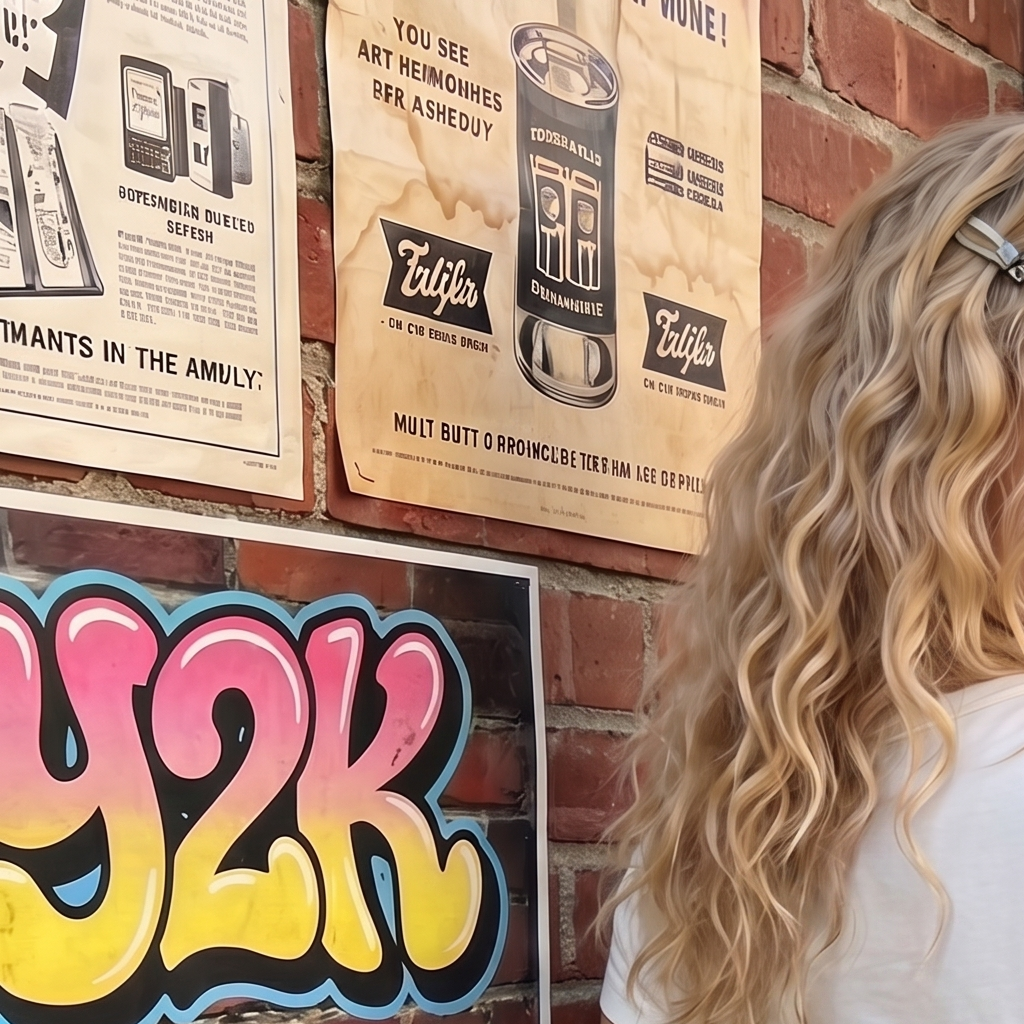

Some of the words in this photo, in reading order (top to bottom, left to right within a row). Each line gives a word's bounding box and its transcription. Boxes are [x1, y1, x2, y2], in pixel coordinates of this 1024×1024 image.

[358, 39, 393, 70] ART
[393, 16, 431, 50] YOU
[438, 37, 469, 67] SEE
[167, 219, 214, 244] SEFESH
[103, 339, 125, 364] IN
[135, 346, 178, 375] THE
[394, 412, 434, 438] MULT
[441, 422, 479, 448] BUTT
[0, 597, 484, 1007] Y2K
